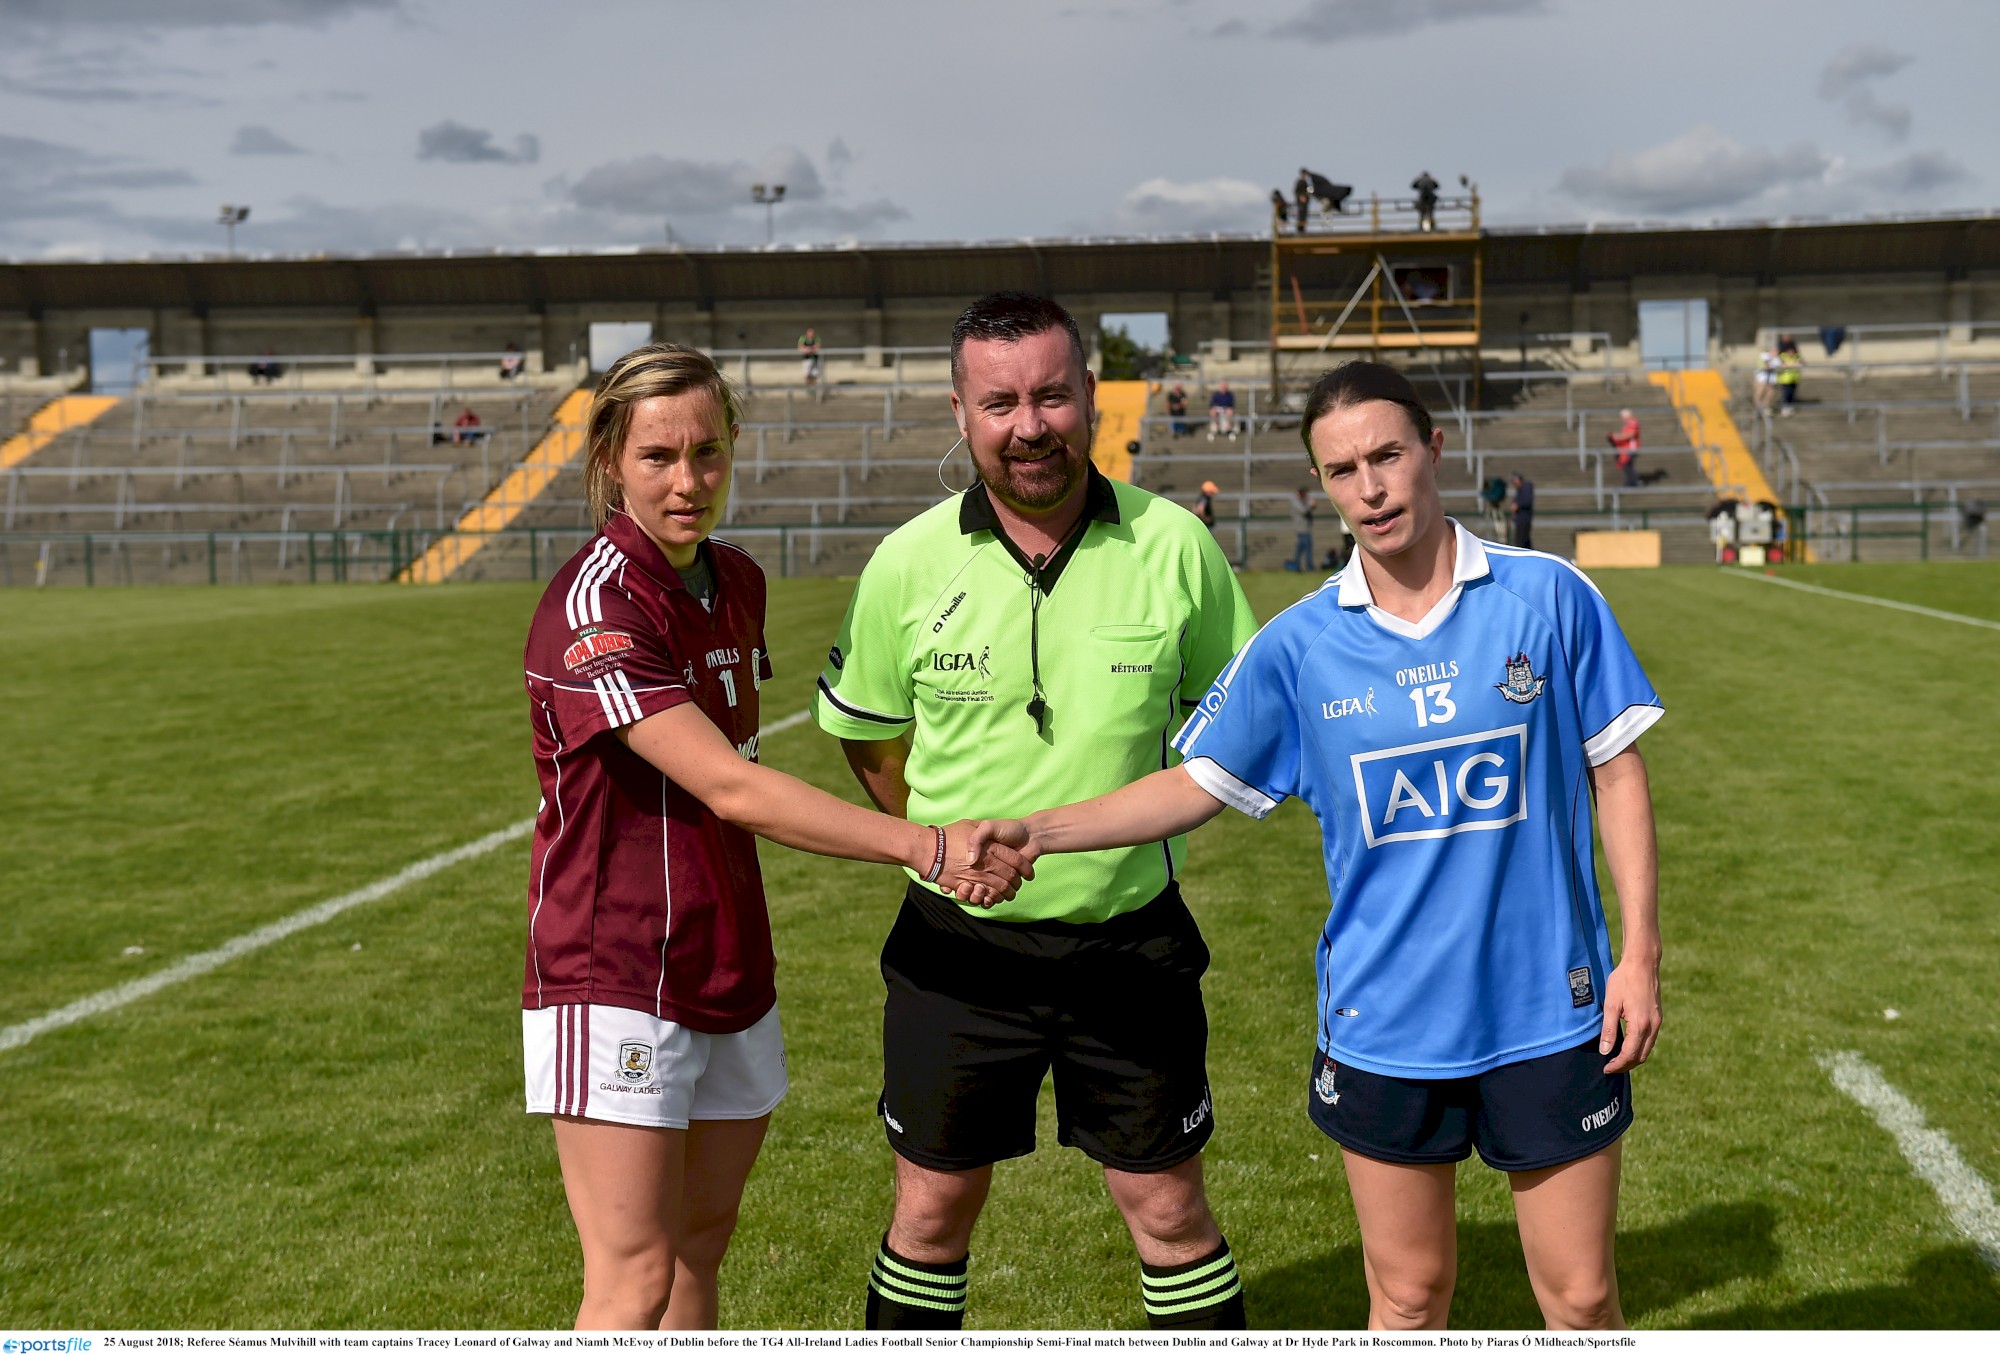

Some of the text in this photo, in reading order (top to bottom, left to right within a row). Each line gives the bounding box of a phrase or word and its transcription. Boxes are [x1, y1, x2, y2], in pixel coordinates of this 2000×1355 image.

[579, 627, 598, 637] PIZZA
[565, 639, 593, 668] PAPA
[933, 652, 976, 672] LGFA
[574, 664, 594, 676] Better
[587, 668, 605, 679] Better
[1110, 661, 1153, 673] RÉITEOIR
[1396, 660, 1459, 687] O'NEILLS
[1322, 697, 1365, 720] LGFA
[1408, 681, 1457, 728] 13
[1383, 752, 1510, 825] AIG
[600, 1083, 632, 1093] GALWAY
[1582, 1096, 1620, 1132] O'NEILLS
